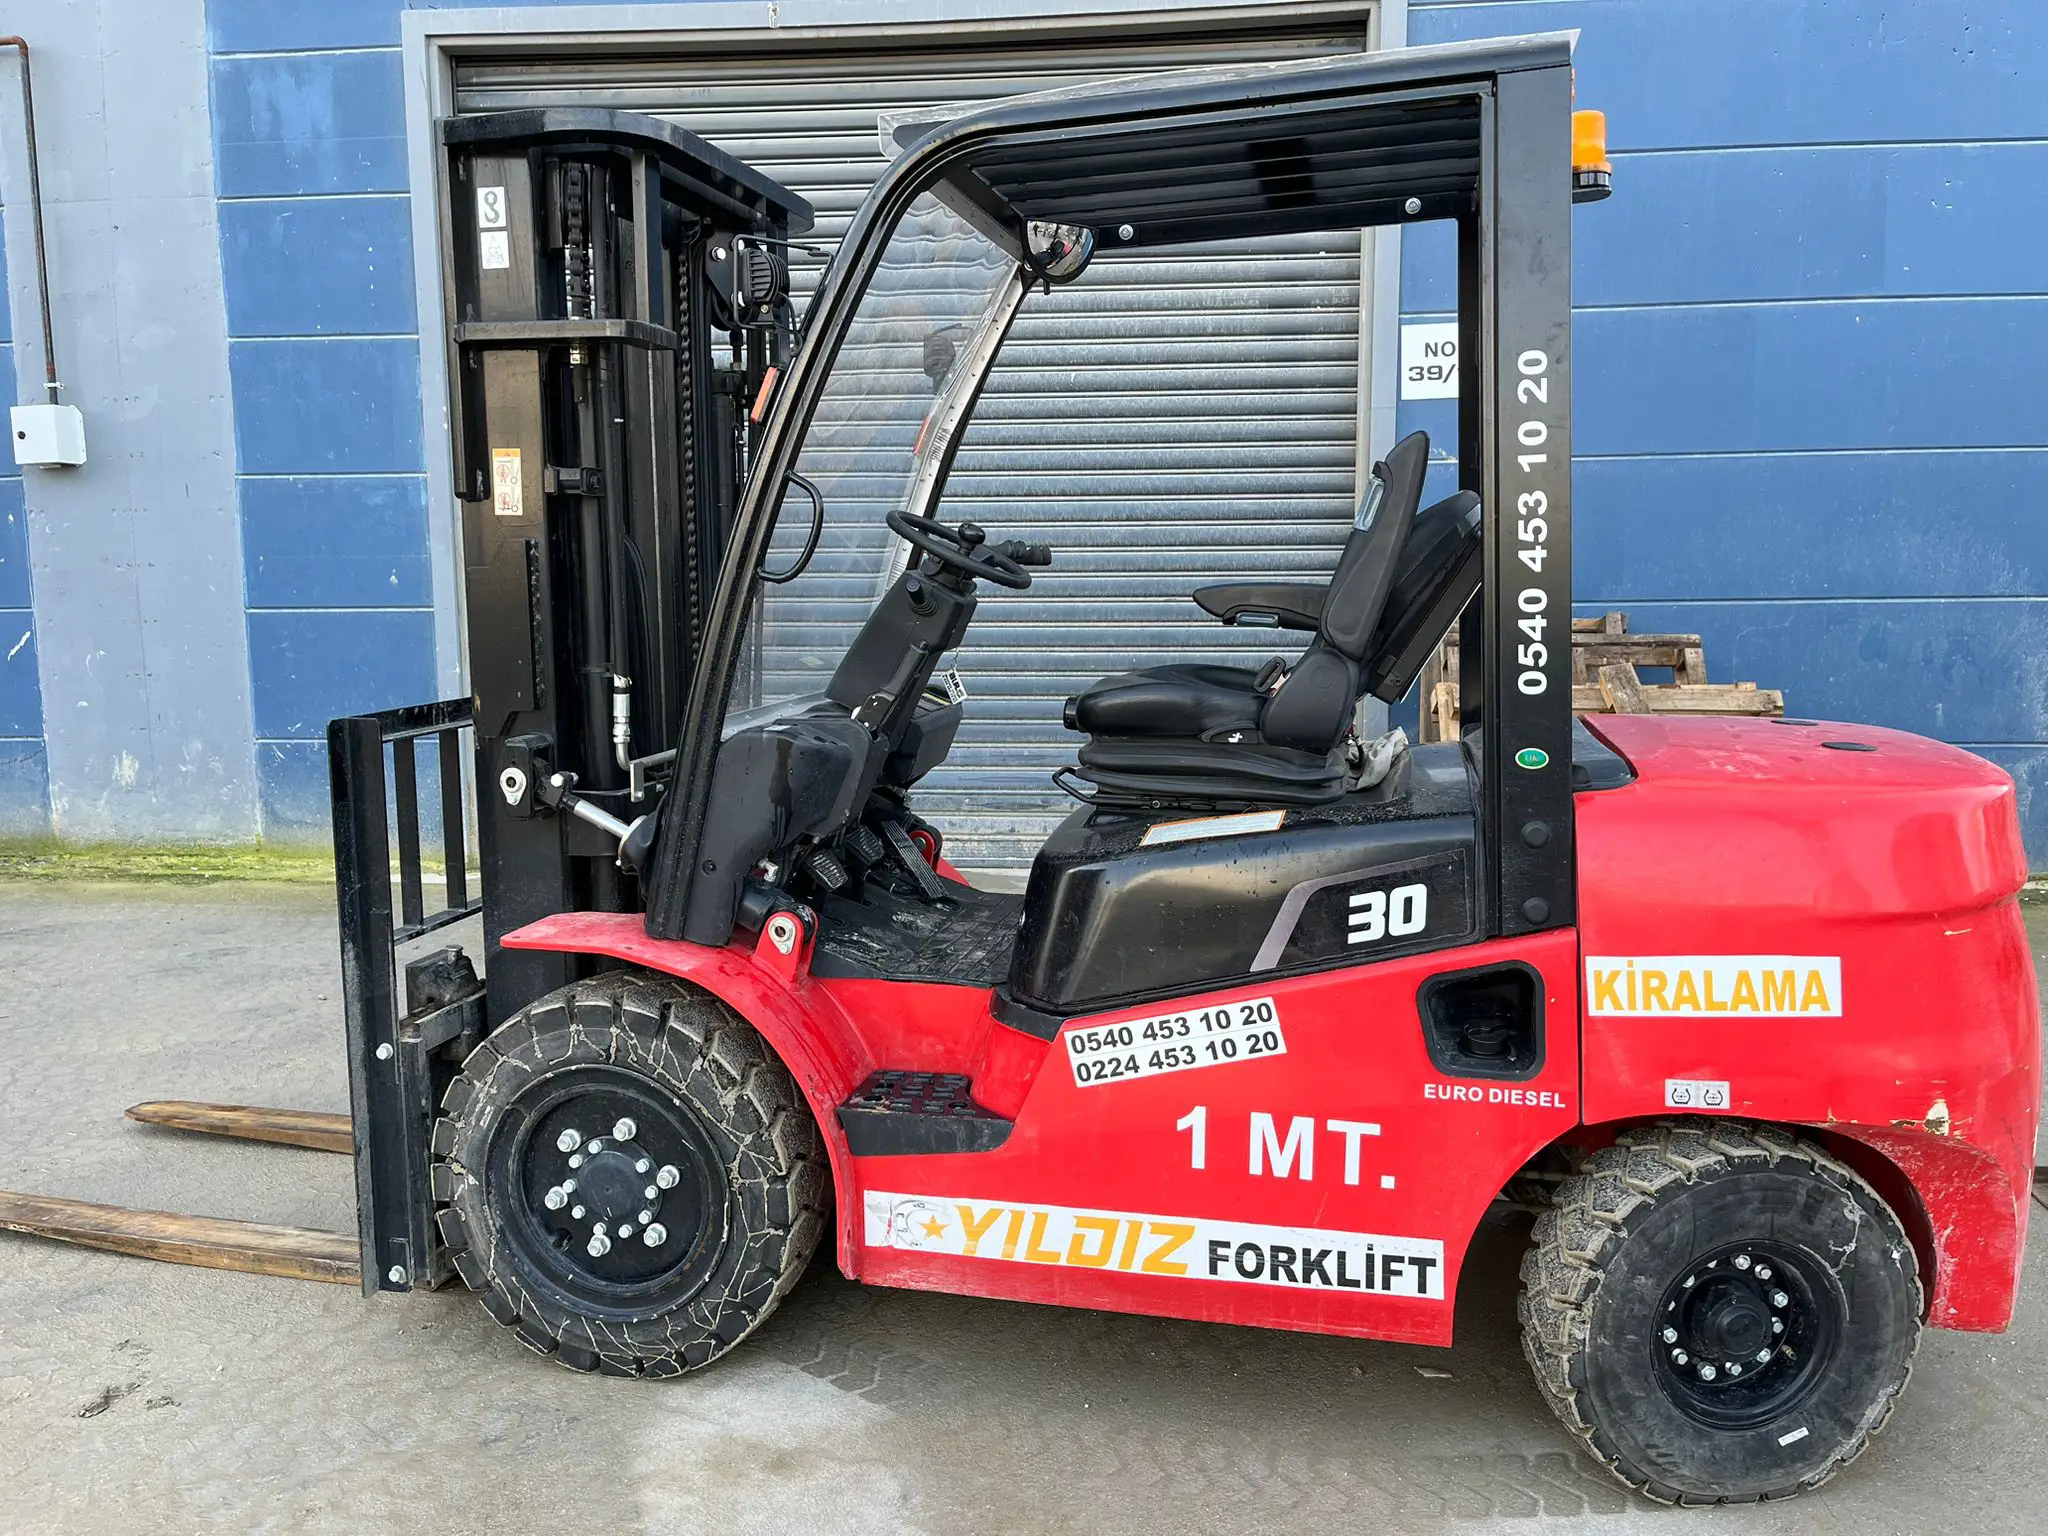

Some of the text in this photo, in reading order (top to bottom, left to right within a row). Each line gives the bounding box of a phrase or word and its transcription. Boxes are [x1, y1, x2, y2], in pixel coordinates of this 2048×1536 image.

[1408, 363, 1459, 384] 39/
[1424, 341, 1456, 358] NO
[1516, 349, 1548, 695] 0540 453 10 20
[1347, 883, 1428, 945] 30
[1594, 960, 1831, 1012] KİRALAMA
[1071, 1002, 1273, 1054] 0540 453 10 20
[1076, 1031, 1279, 1082] 0224 453 10 20
[1424, 1083, 1566, 1108] EURO DIESEL
[1176, 1105, 1396, 1190] 1 MT.
[955, 1204, 1438, 1296] YILDIZ FORKLİFT
